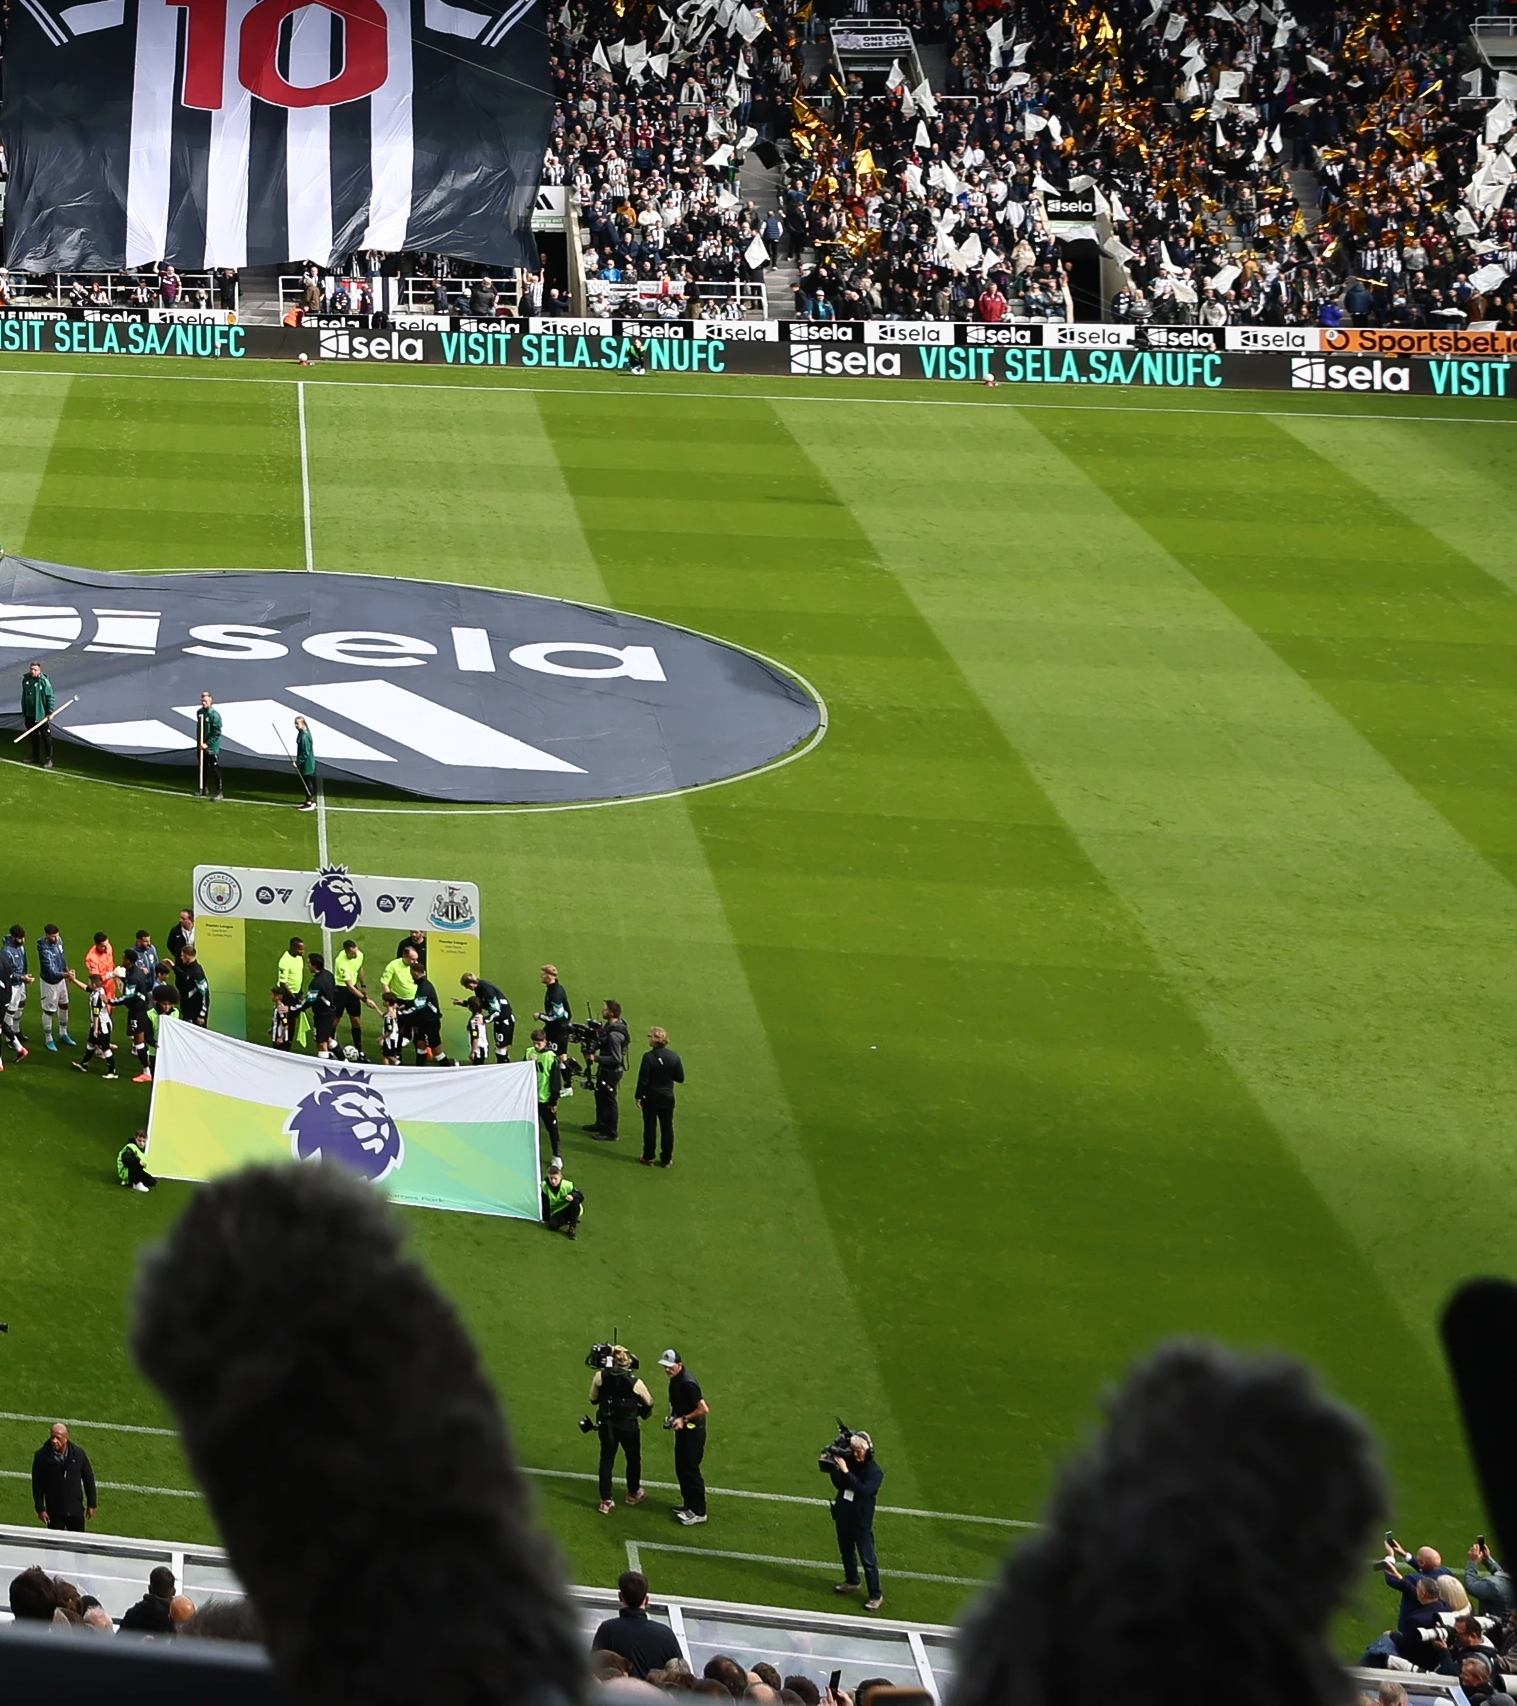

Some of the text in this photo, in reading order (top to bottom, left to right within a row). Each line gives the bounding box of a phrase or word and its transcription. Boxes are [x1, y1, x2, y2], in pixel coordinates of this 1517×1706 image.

[1060, 199, 1093, 213] sela
[398, 316, 439, 331] sela
[477, 318, 520, 333] sela
[560, 319, 601, 335] sela
[641, 321, 684, 338] sela
[724, 322, 766, 341] sela
[809, 323, 852, 341] sela
[54, 320, 246, 358] SELA.SA/NUFC
[898, 325, 940, 342] sela
[986, 326, 1031, 344] sela
[1077, 328, 1121, 345] sela
[1168, 329, 1214, 346] sela
[1261, 331, 1305, 347] sela
[352, 331, 424, 361] sela
[441, 332, 726, 373] VISIT SELA.SANUFC
[824, 346, 902, 376] sela
[918, 346, 1223, 387] VISIT SELA.SA/NUFC
[1327, 359, 1410, 391] sela
[1429, 360, 1511, 396] VISIT
[181, 621, 669, 682] sela
[203, 874, 237, 890] MANCHESTER
